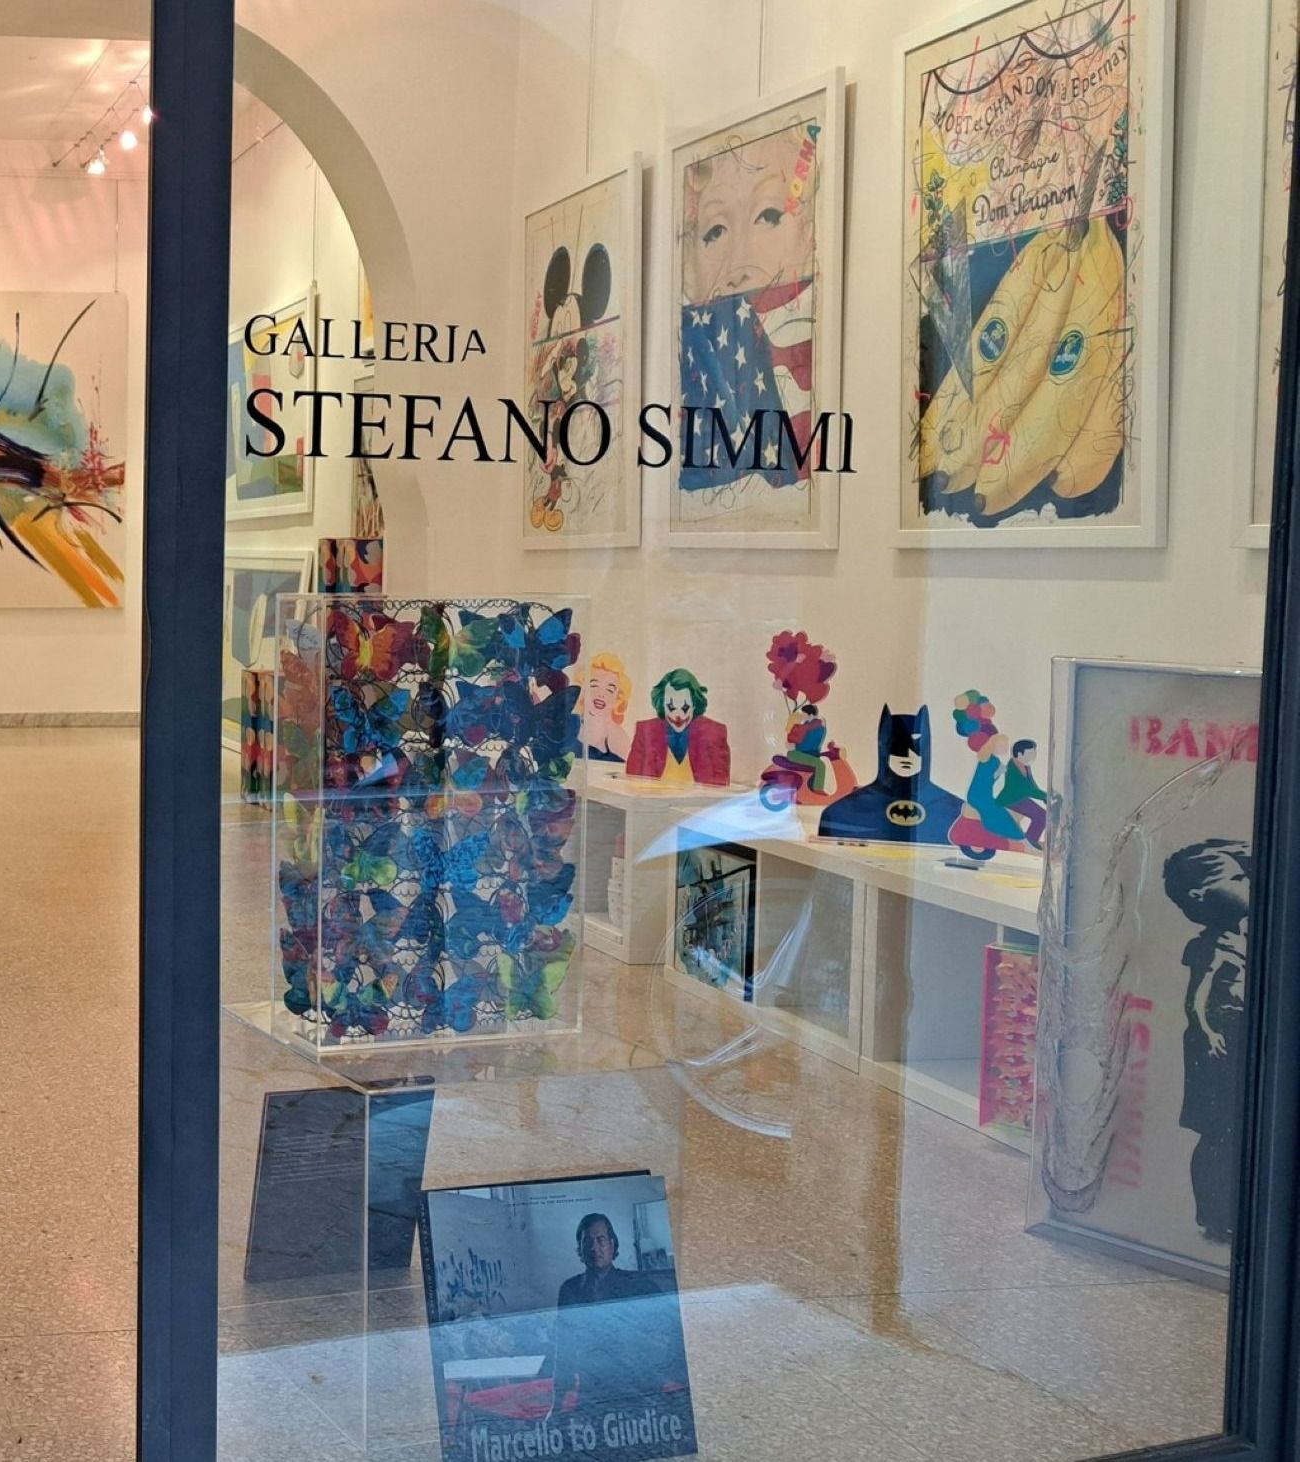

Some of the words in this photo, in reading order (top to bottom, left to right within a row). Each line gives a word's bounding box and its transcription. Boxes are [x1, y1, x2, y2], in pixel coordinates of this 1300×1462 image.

[984, 77, 1057, 127] CHANDON
[989, 151, 1061, 181] Champagne
[971, 194, 1009, 226] Dom
[244, 314, 486, 363] GALLERIA
[245, 388, 611, 465] STEFANO
[637, 402, 857, 473] SIMMI
[471, 1420, 564, 1462] Marcello
[603, 1408, 683, 1448] Giudice
